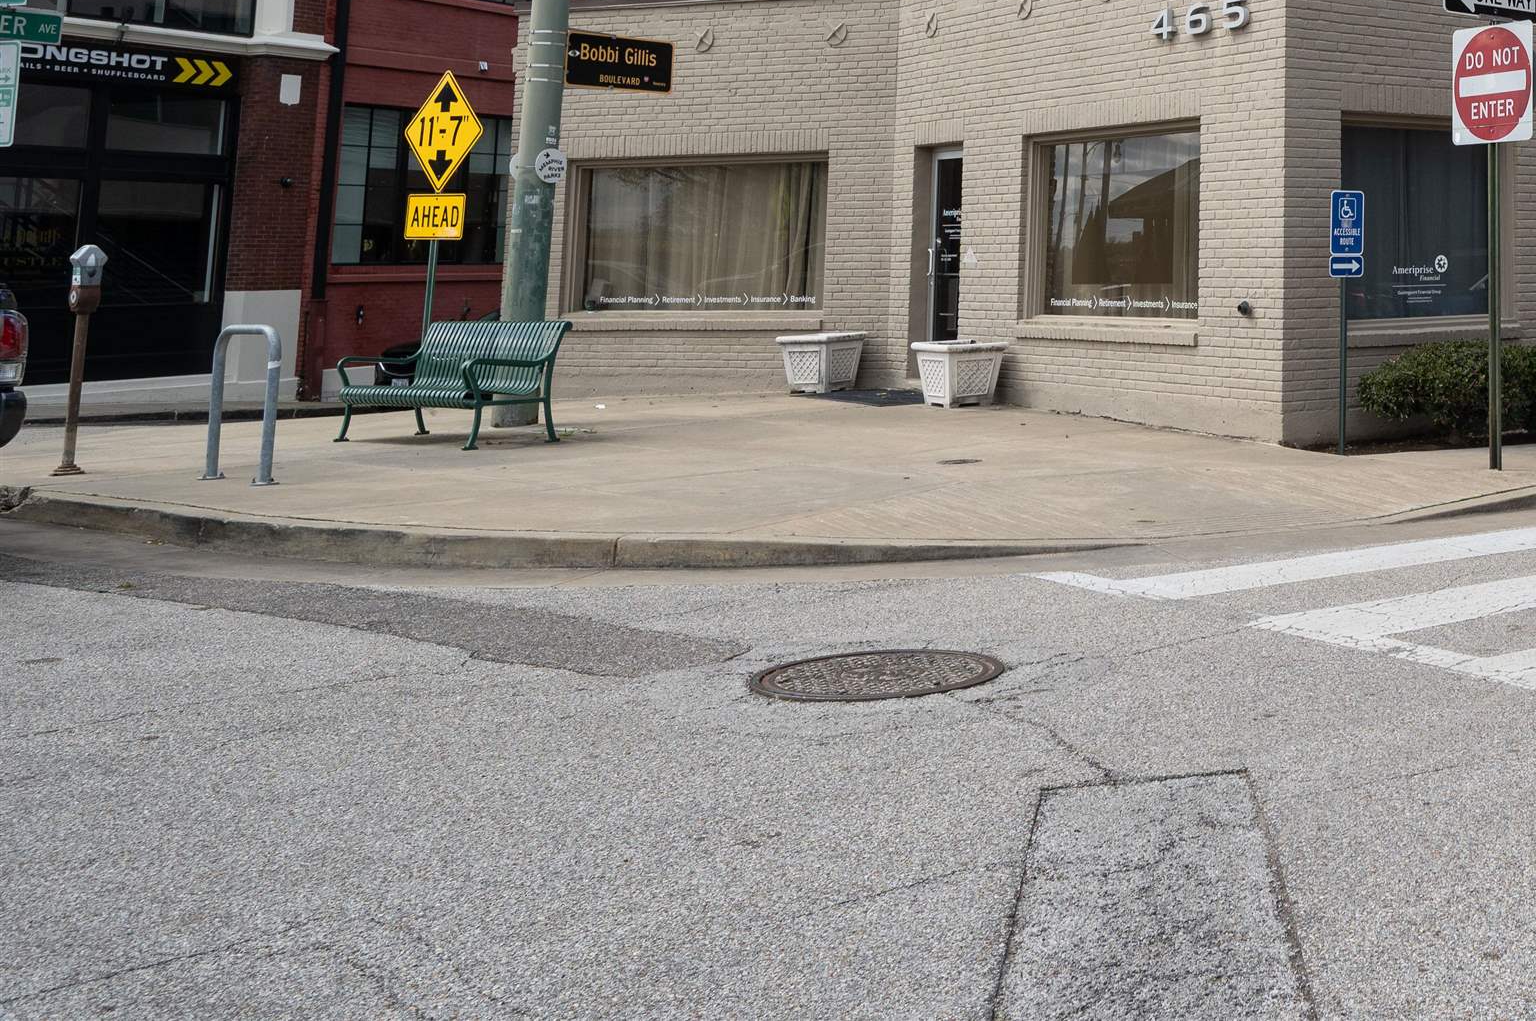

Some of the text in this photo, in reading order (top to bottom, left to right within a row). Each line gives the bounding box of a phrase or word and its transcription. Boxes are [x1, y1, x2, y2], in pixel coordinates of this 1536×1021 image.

[38, 23, 57, 34] AVE
[580, 42, 657, 67] Bobbi Gillis
[1465, 46, 1520, 70] DO NOT
[54, 65, 79, 74] BEER
[91, 68, 166, 82] SHUFFLEBOARD
[599, 74, 641, 86] BOULEVARD
[1471, 98, 1514, 120] ENTER
[539, 159, 563, 172] MEMPHIS
[411, 205, 460, 228] AHEAD
[1333, 227, 1361, 236] ACCESSIBLE
[1339, 238, 1355, 246] ROUTE
[1392, 264, 1434, 277] Ameriprise
[628, 296, 654, 305] Planning
[704, 296, 742, 304] Investments
[751, 296, 782, 304] Insurance
[790, 295, 816, 305] Banking
[1050, 298, 1072, 306] Financial
[1072, 298, 1092, 308] Planning
[1099, 298, 1126, 307] Retirement
[1133, 300, 1164, 308] Investments
